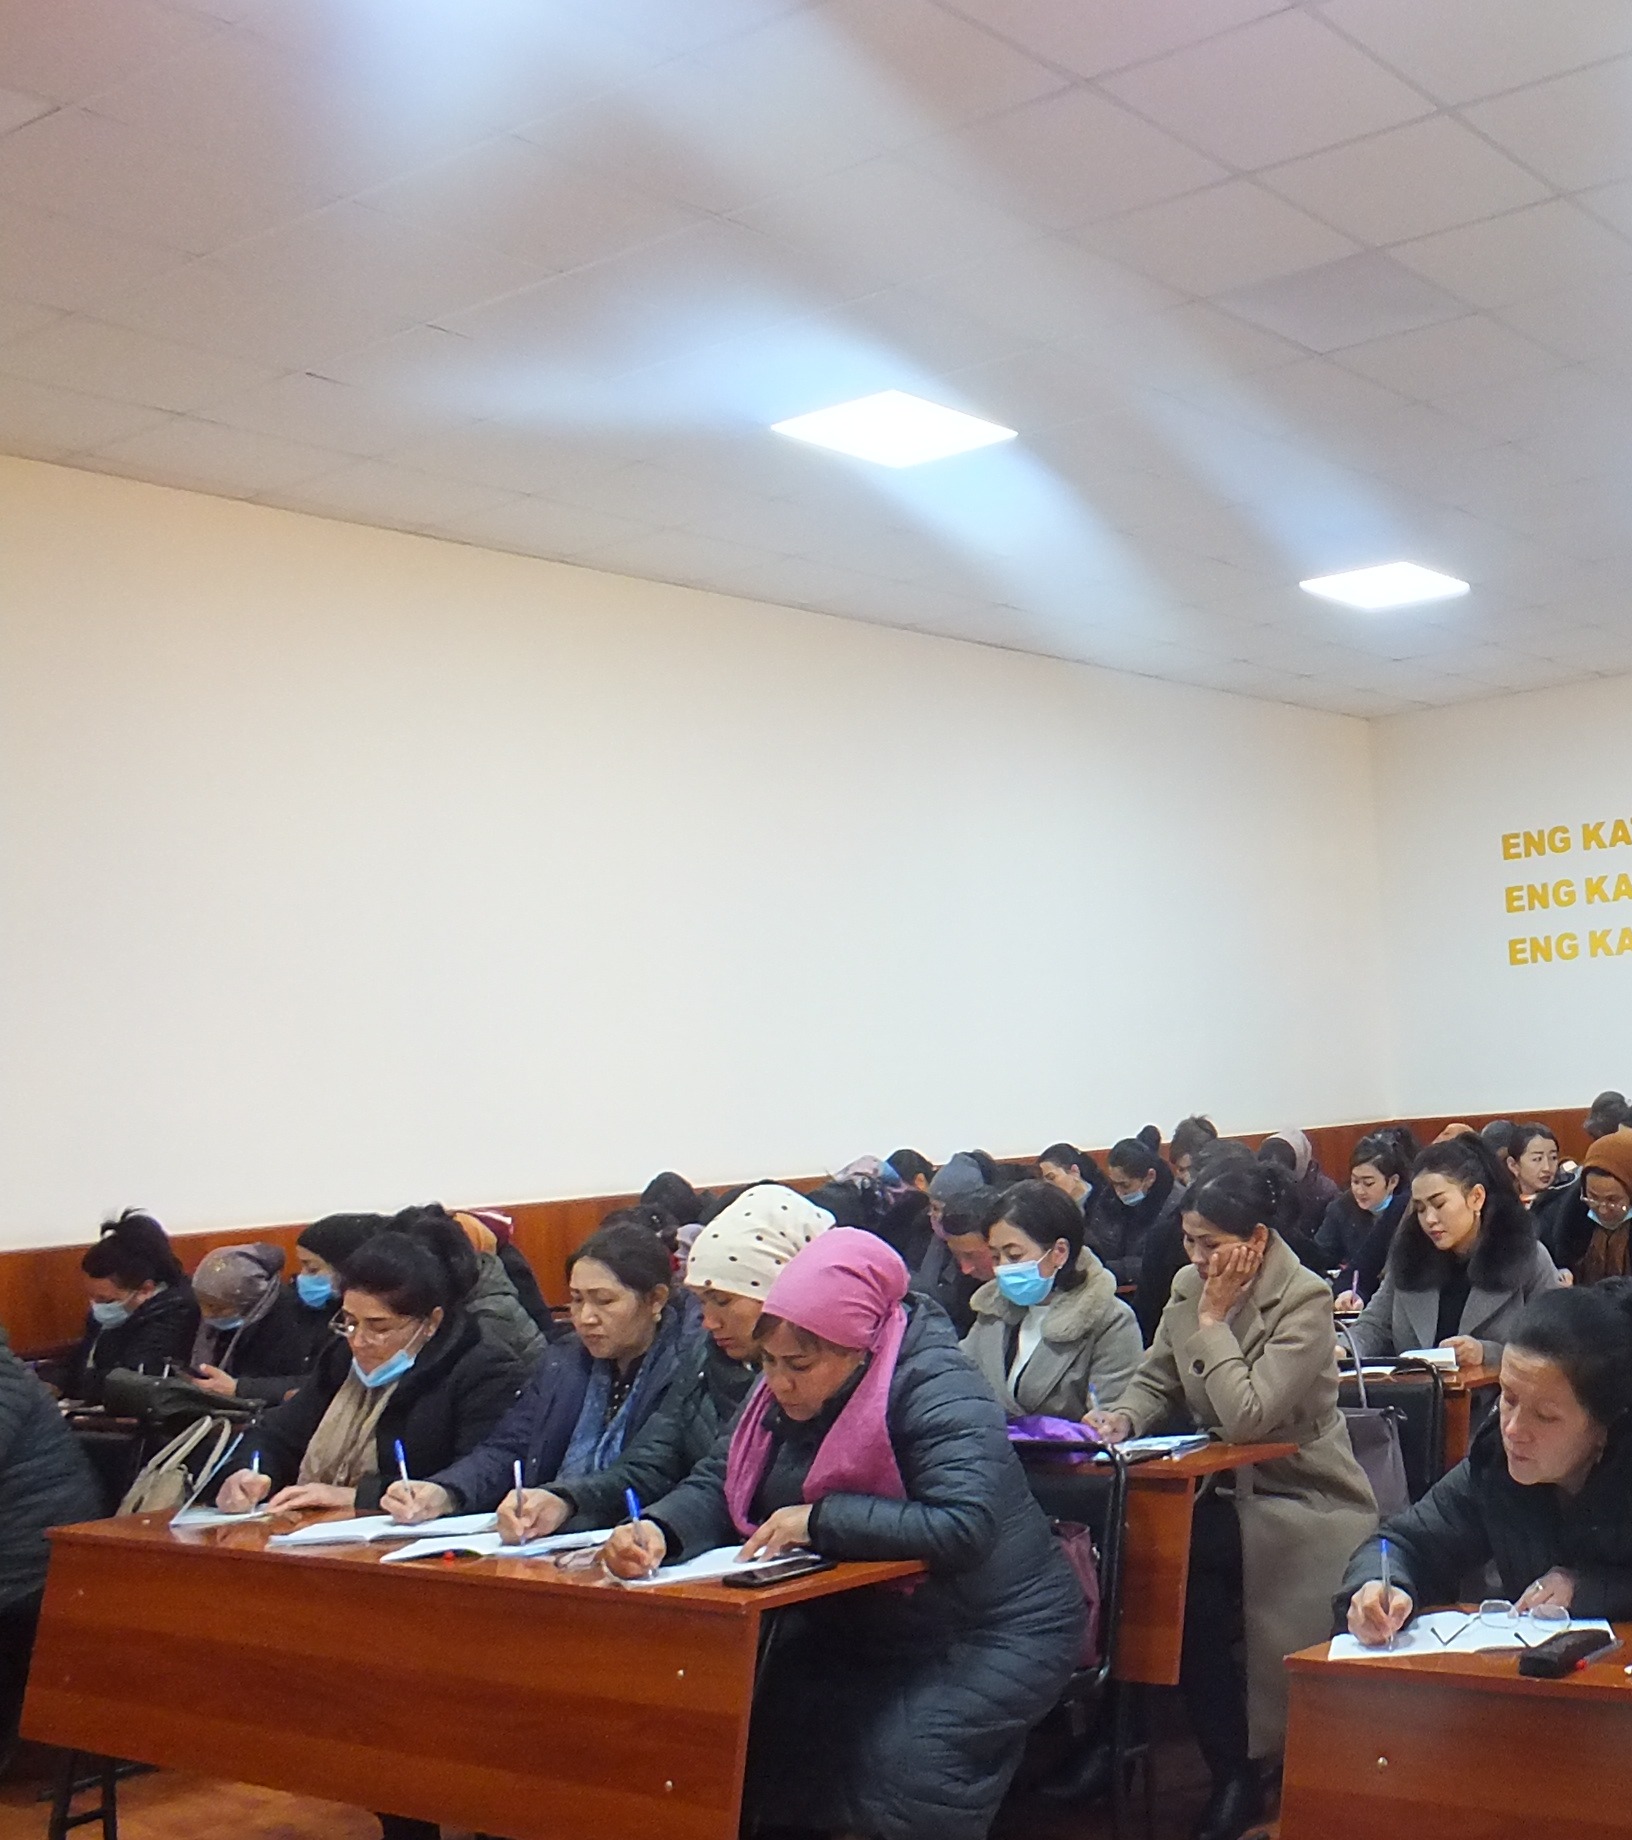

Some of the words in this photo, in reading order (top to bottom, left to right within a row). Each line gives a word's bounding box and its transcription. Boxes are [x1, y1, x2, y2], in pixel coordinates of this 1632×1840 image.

[1501, 825, 1572, 861] ENG
[1504, 877, 1577, 914] ENG
[1508, 930, 1579, 967] ENG
